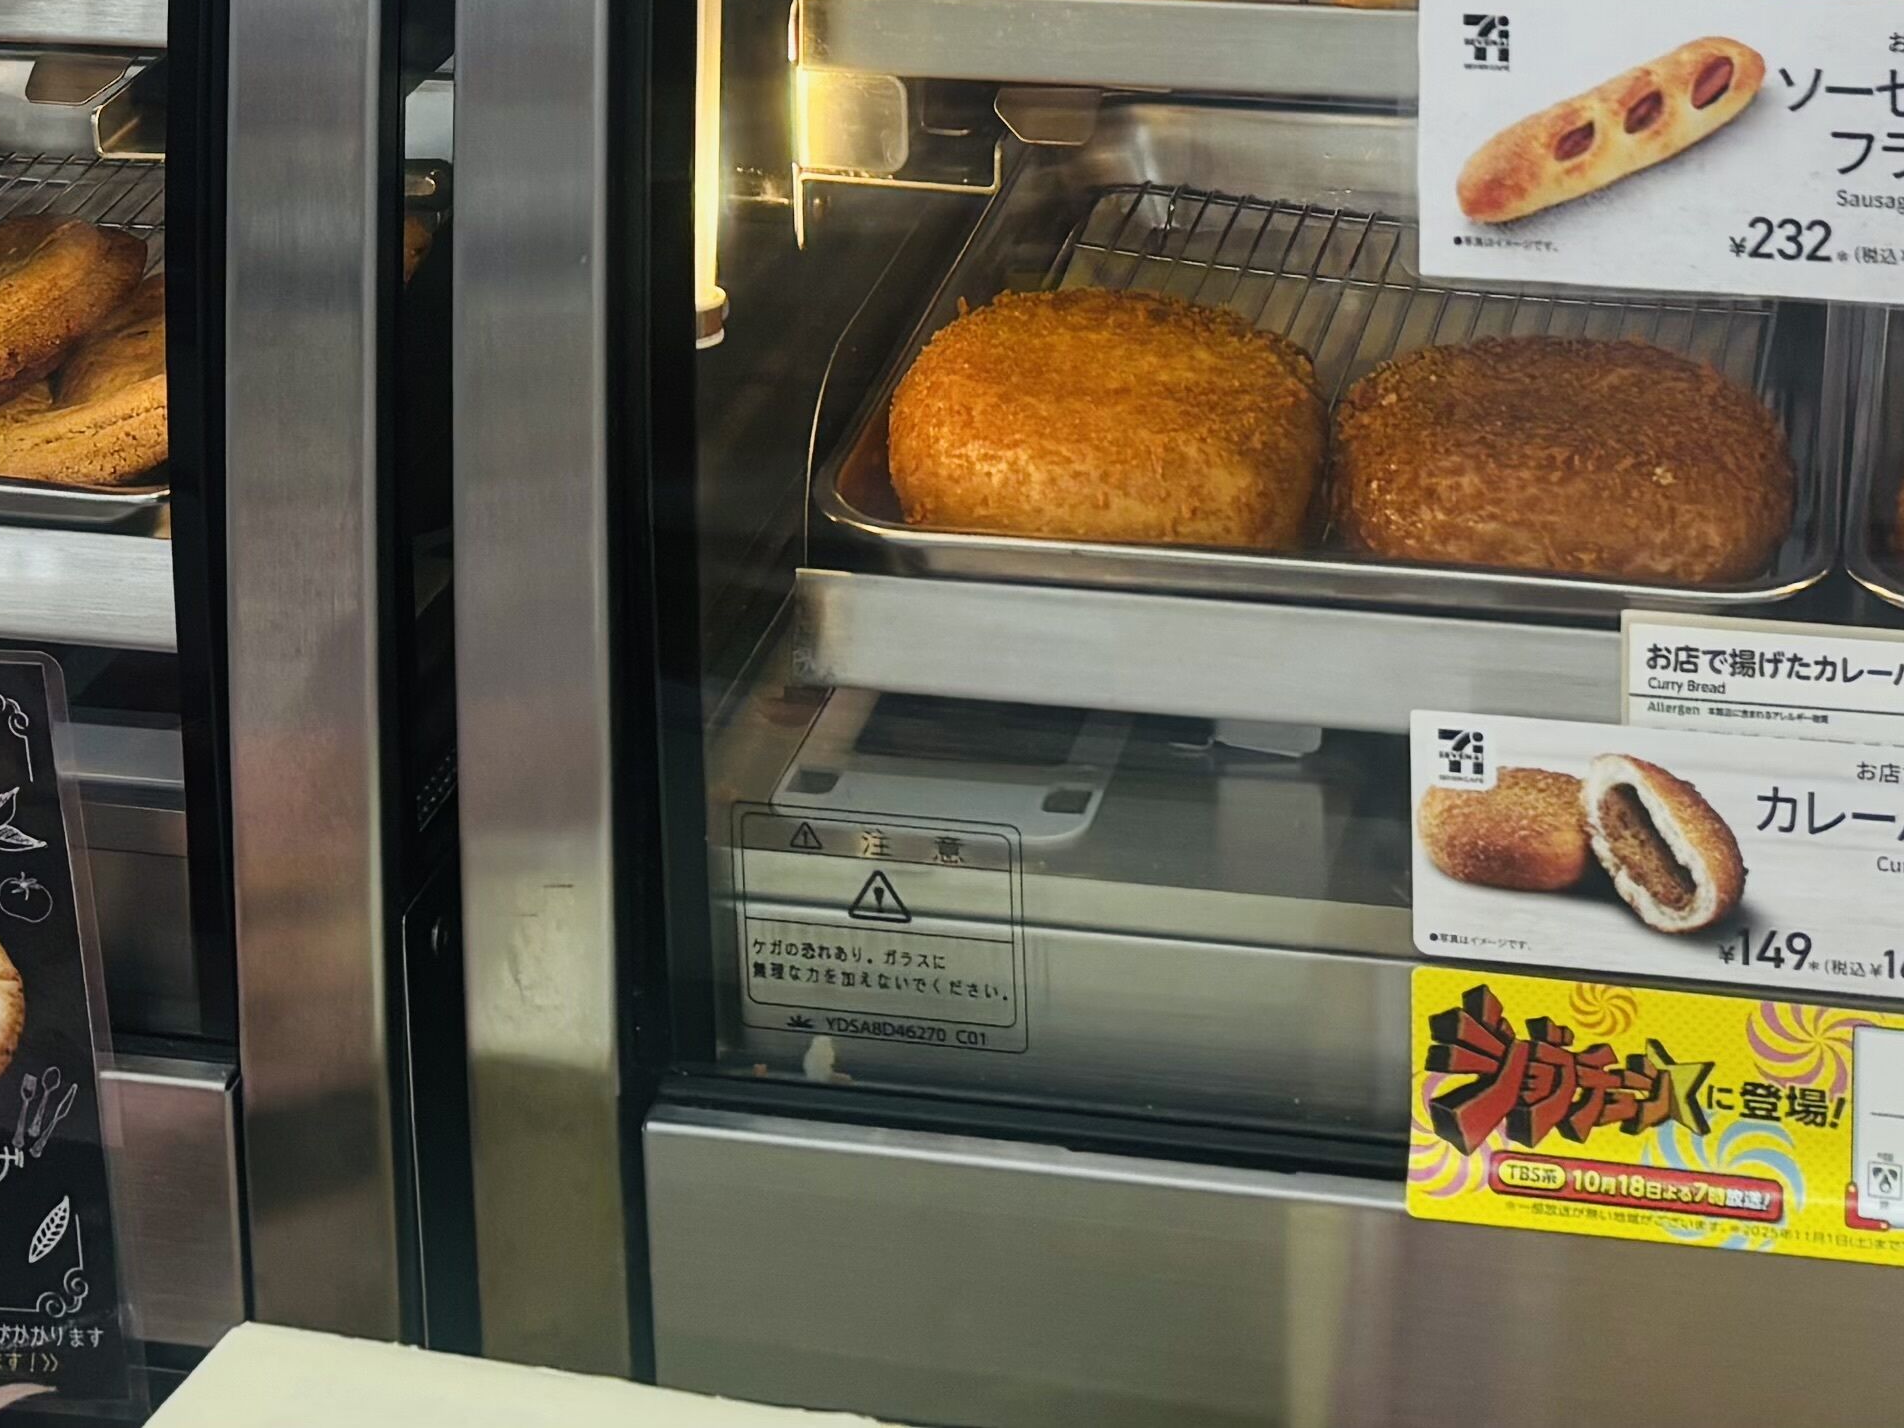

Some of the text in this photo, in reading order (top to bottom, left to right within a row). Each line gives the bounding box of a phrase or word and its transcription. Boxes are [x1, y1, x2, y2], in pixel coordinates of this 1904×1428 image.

[1647, 677, 1726, 696] Curry Bread
[1647, 701, 1701, 717] Allergen
[1508, 1164, 1558, 1186] TBS系
